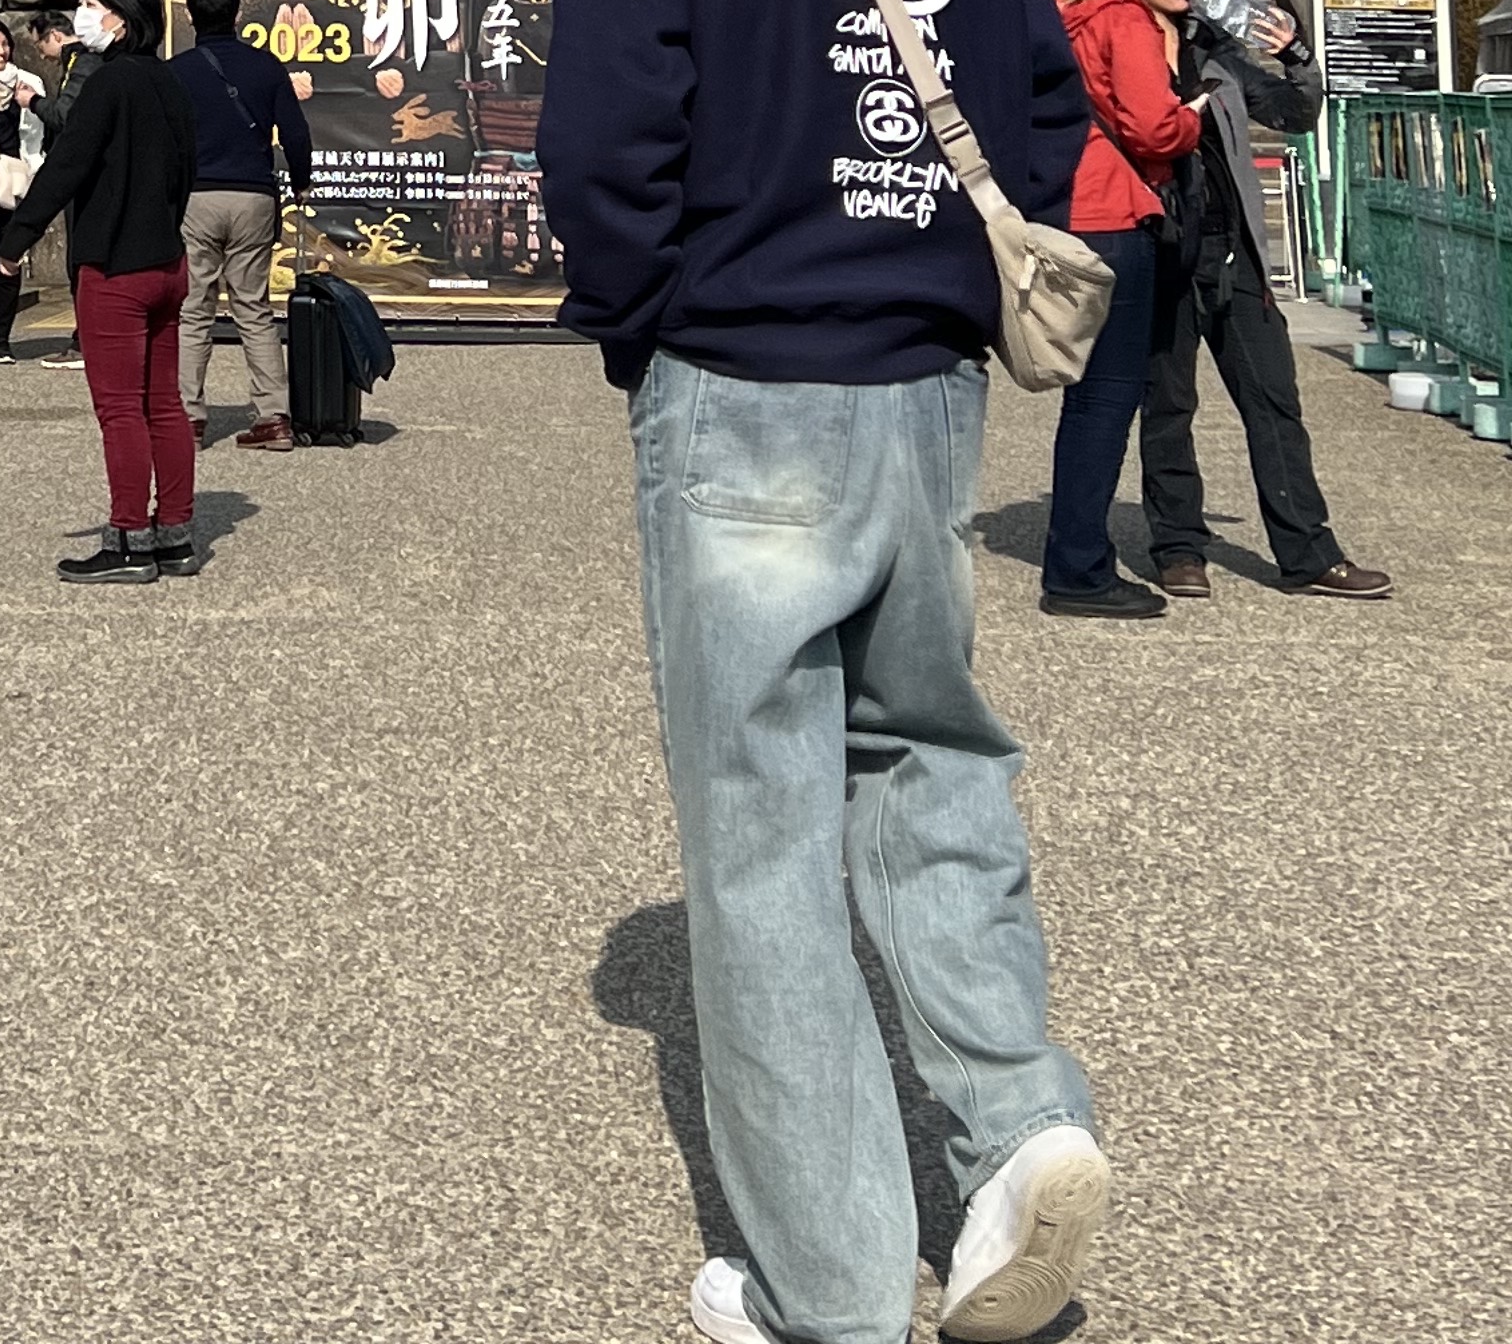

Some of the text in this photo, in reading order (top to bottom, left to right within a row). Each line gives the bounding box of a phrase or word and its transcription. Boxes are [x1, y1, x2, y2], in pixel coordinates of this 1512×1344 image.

[241, 22, 352, 63] 2023
[835, 7, 938, 43] COMN
[832, 157, 958, 192] BROOKLYN
